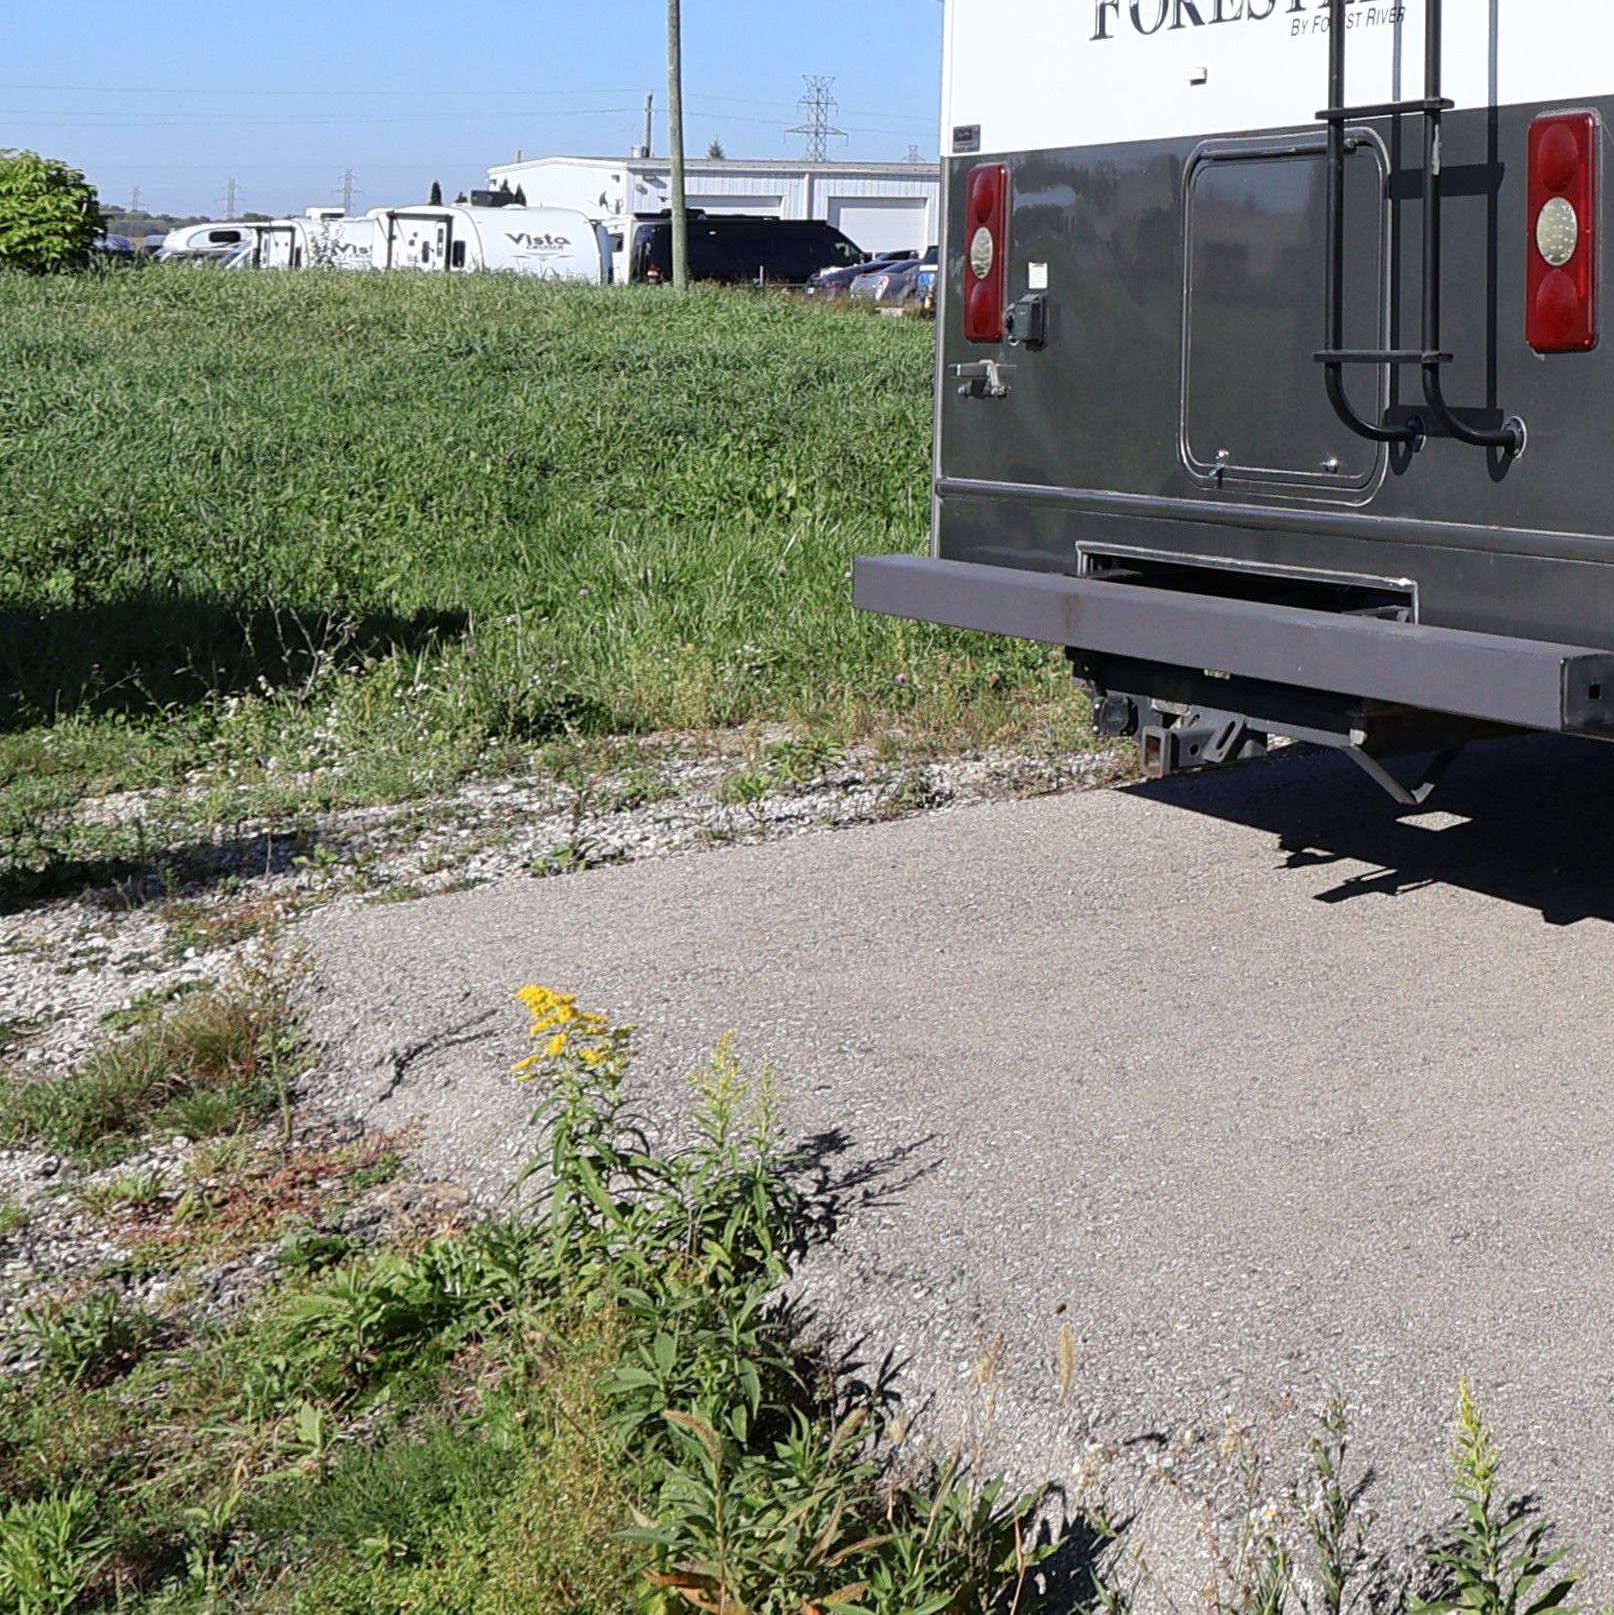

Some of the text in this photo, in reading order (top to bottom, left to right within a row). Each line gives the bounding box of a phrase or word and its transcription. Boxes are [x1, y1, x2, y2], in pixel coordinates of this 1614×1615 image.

[1290, 6, 1406, 37] BY FOST RIVER
[504, 232, 572, 246] Vista
